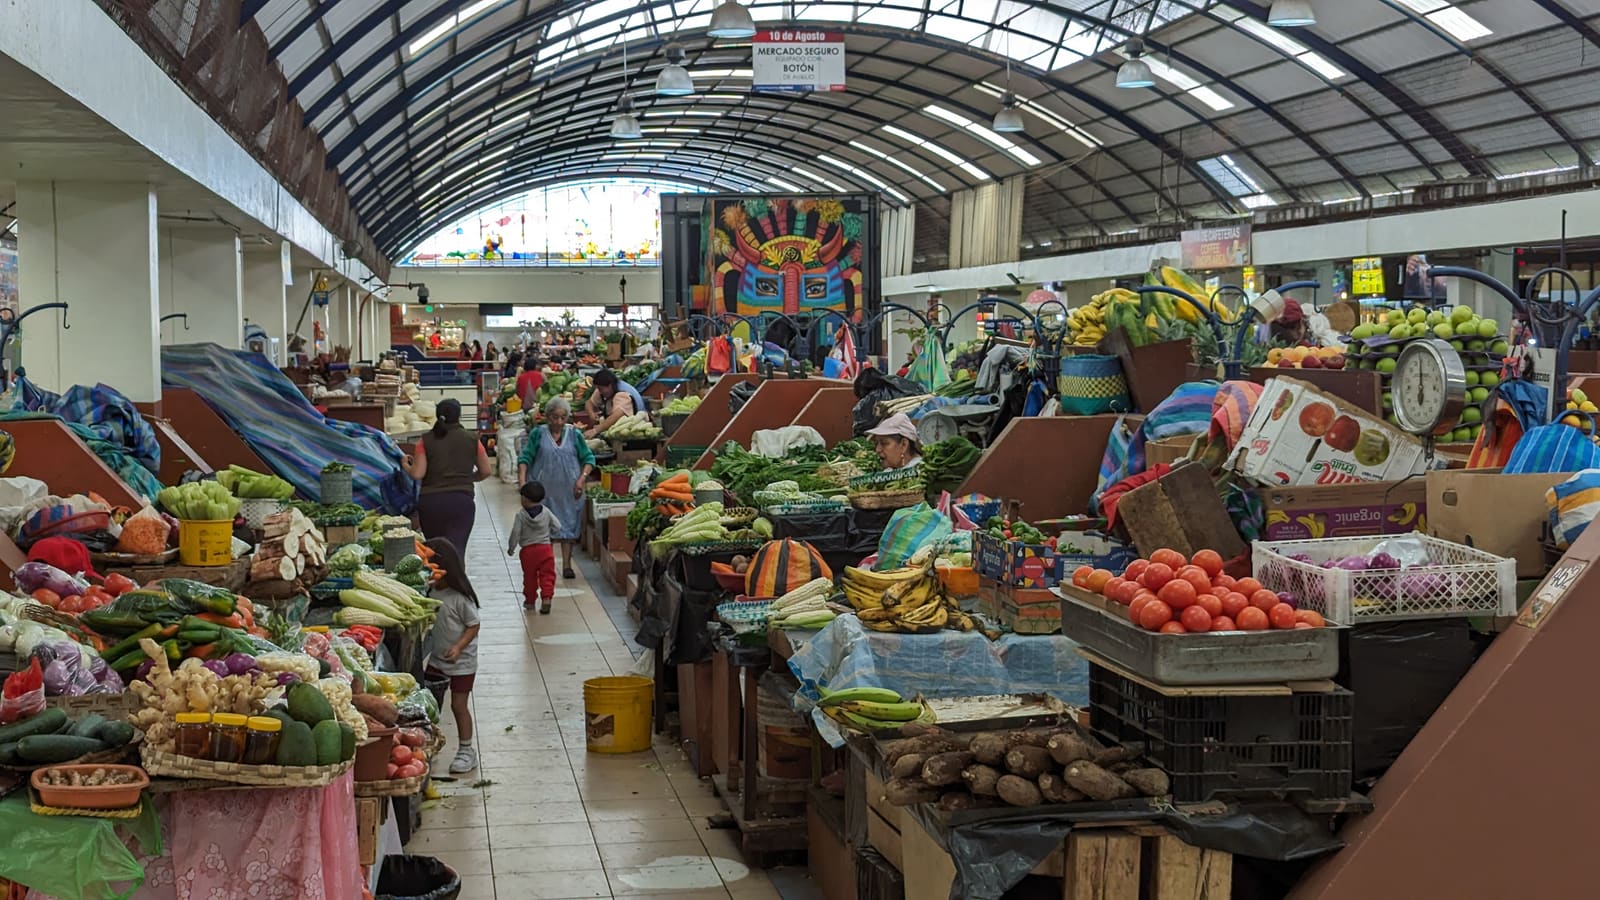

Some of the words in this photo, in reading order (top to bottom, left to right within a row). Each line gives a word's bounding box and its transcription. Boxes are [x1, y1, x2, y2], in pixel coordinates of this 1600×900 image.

[769, 31, 780, 40] 10
[782, 31, 793, 41] de
[795, 31, 826, 42] Agosto
[757, 47, 803, 55] MERCADO
[805, 47, 839, 55] SEGURO
[783, 63, 814, 72] BOTÓN
[1335, 508, 1381, 525] organic
